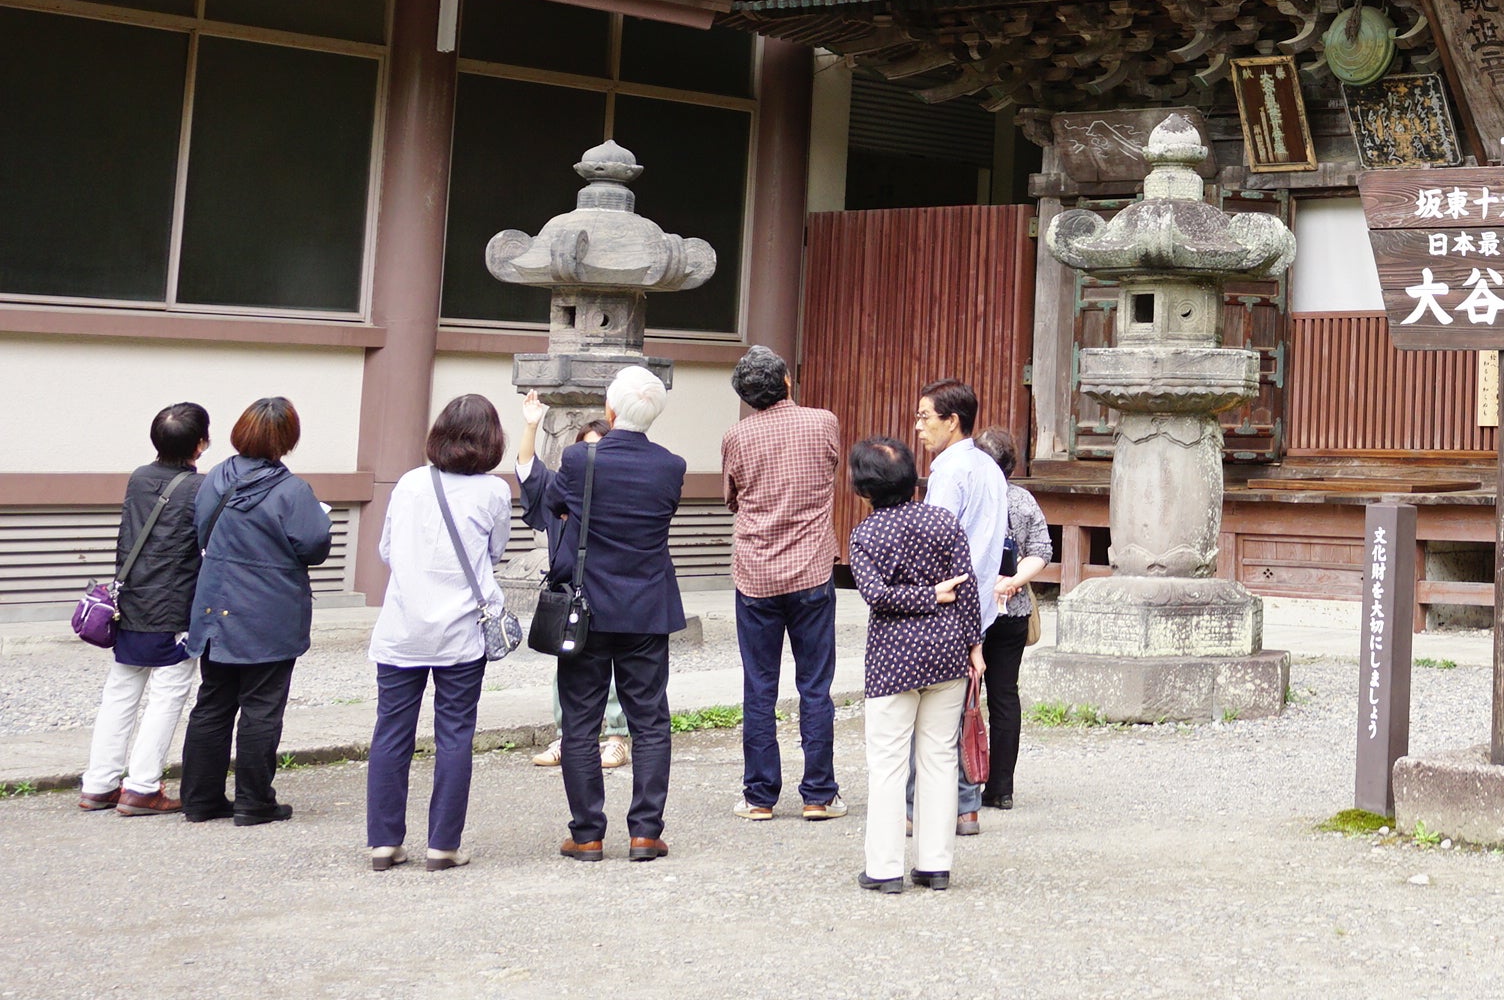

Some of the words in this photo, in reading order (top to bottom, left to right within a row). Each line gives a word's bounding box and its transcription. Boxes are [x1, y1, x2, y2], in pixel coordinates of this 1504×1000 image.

[1368, 526, 1388, 740] 文化財を大切にしましょう
